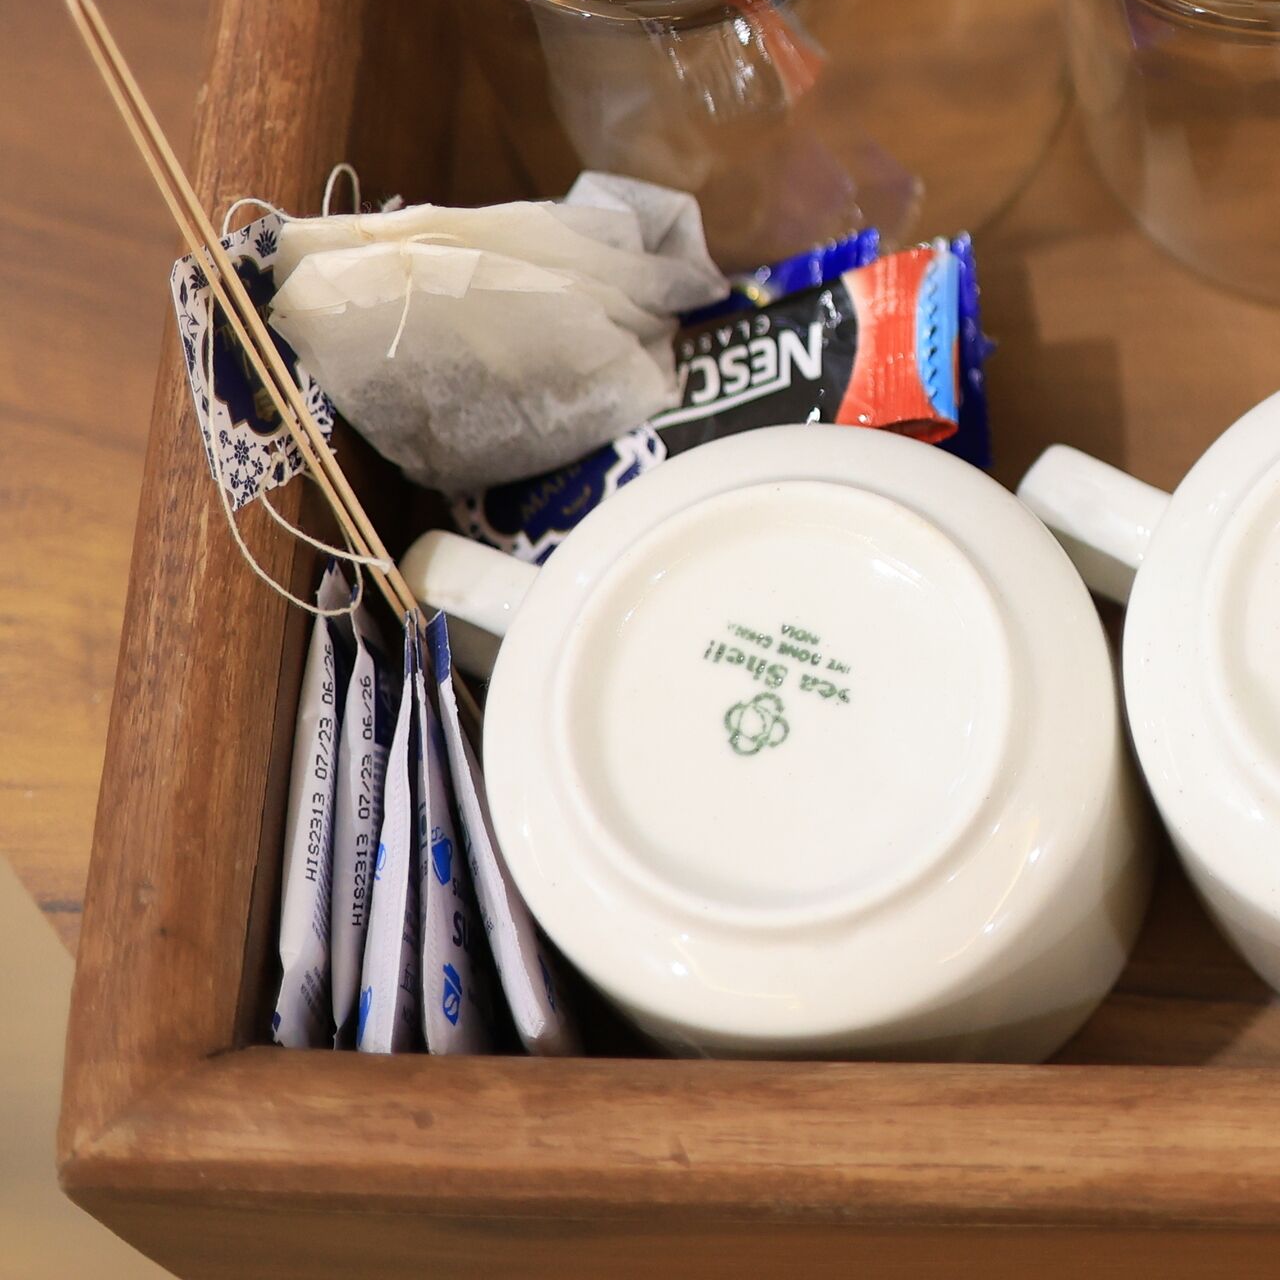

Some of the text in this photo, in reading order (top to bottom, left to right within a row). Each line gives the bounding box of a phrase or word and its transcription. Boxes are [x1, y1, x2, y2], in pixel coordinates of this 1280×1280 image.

[305, 791, 325, 881] HIS2313
[315, 718, 332, 780] 07/23
[352, 675, 373, 926] HIS2313 07/23 06/26
